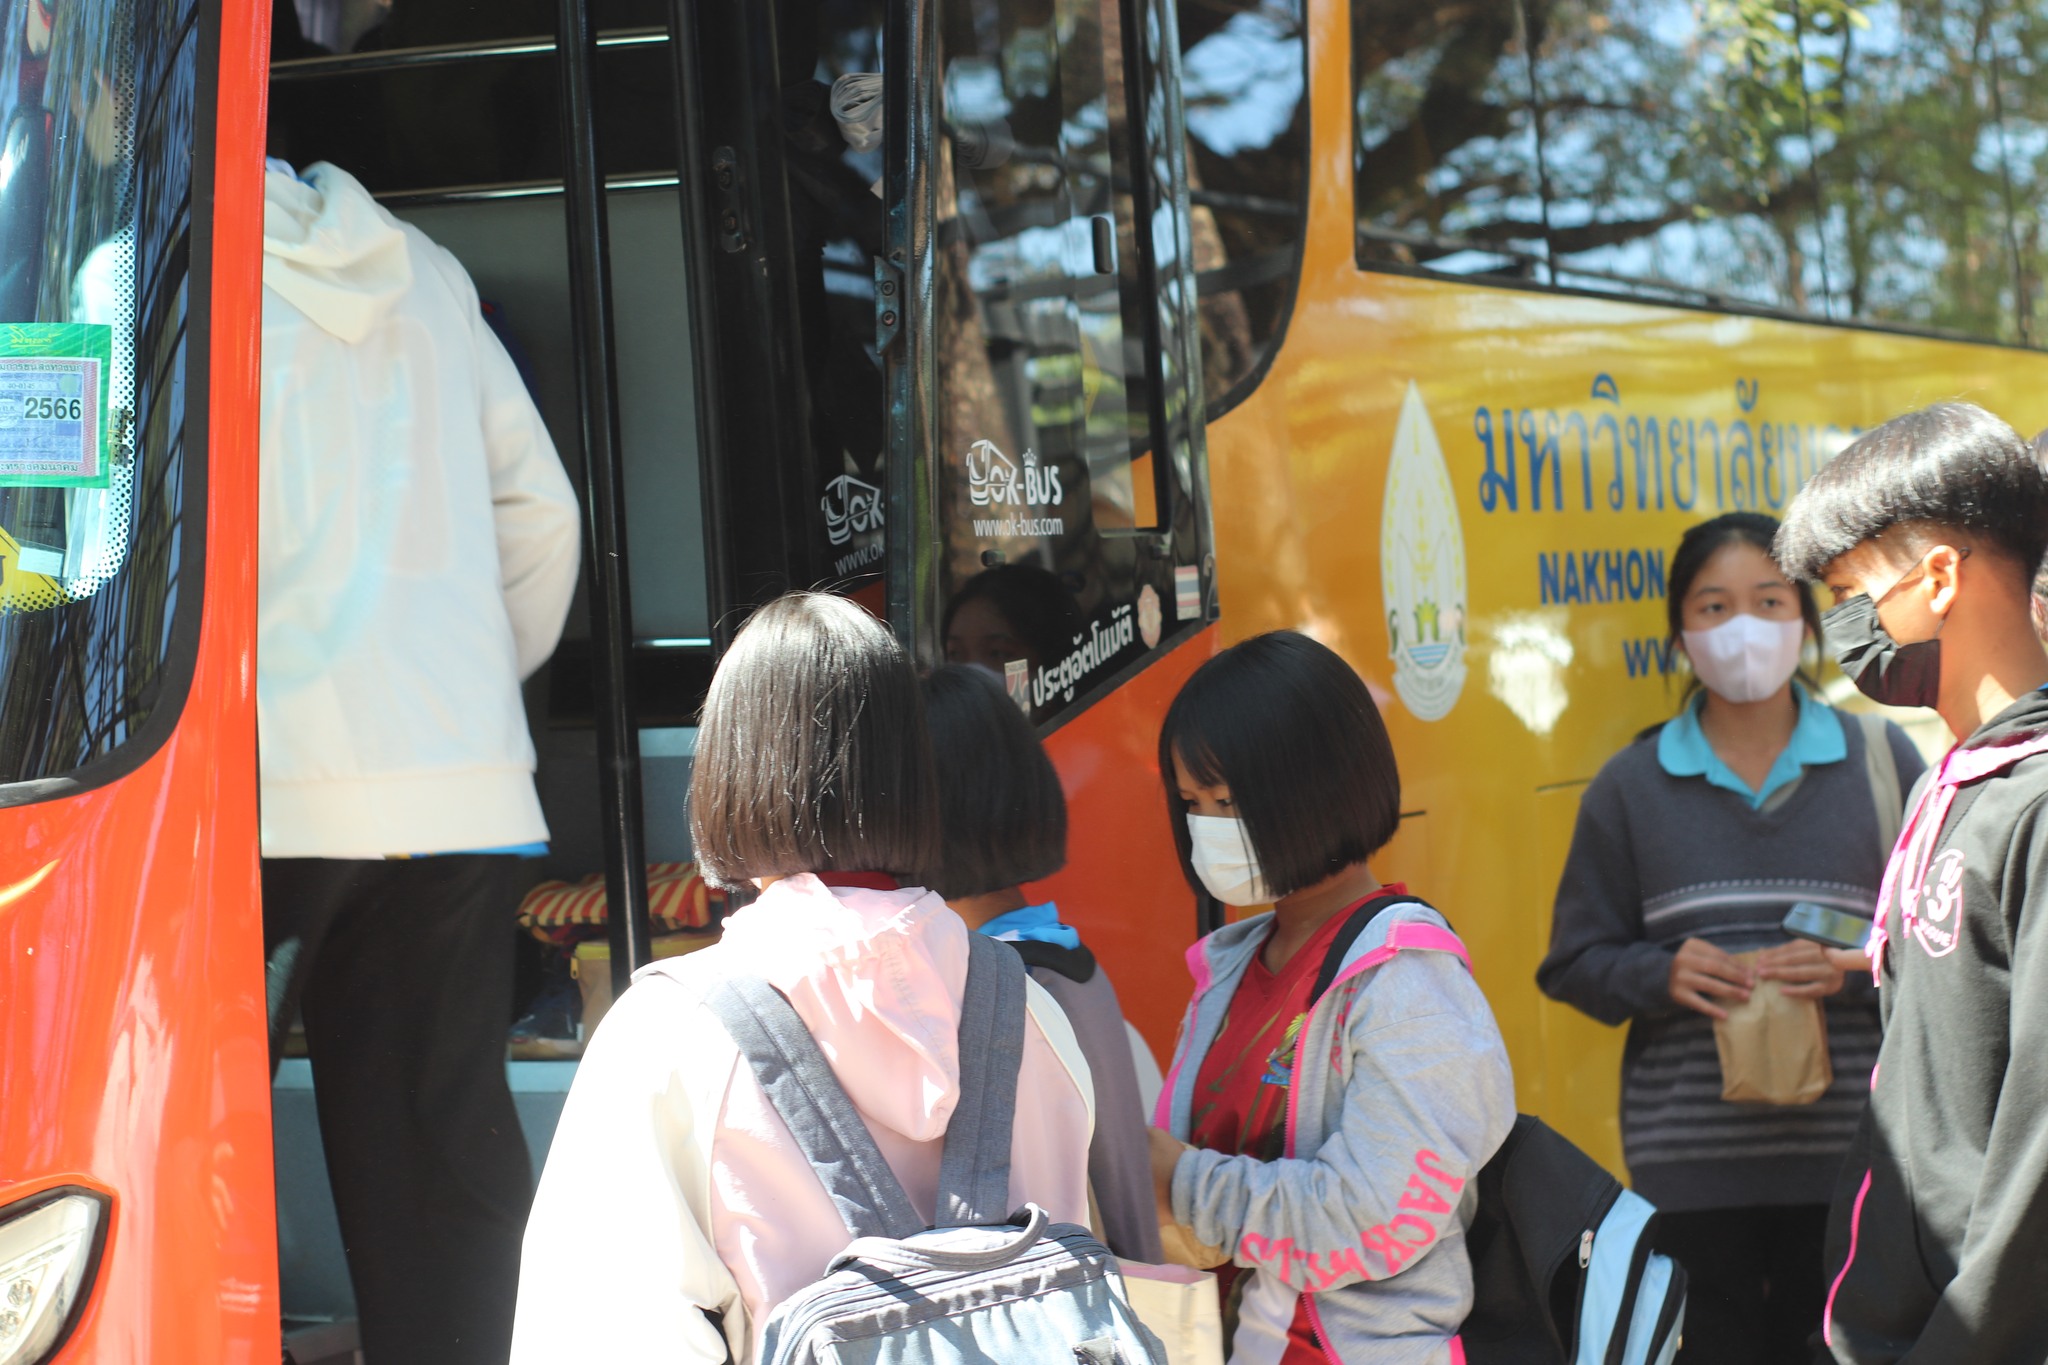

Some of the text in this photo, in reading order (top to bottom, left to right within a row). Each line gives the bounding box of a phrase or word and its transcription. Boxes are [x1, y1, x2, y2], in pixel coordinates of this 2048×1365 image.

[25, 397, 81, 420] 2566
[973, 512, 1064, 537] www.ok-bus.com
[1539, 549, 1665, 605] NAKHON
[1033, 604, 1134, 707] ประตูอัตโนมัติ
[1360, 1149, 1465, 1276] JACK
